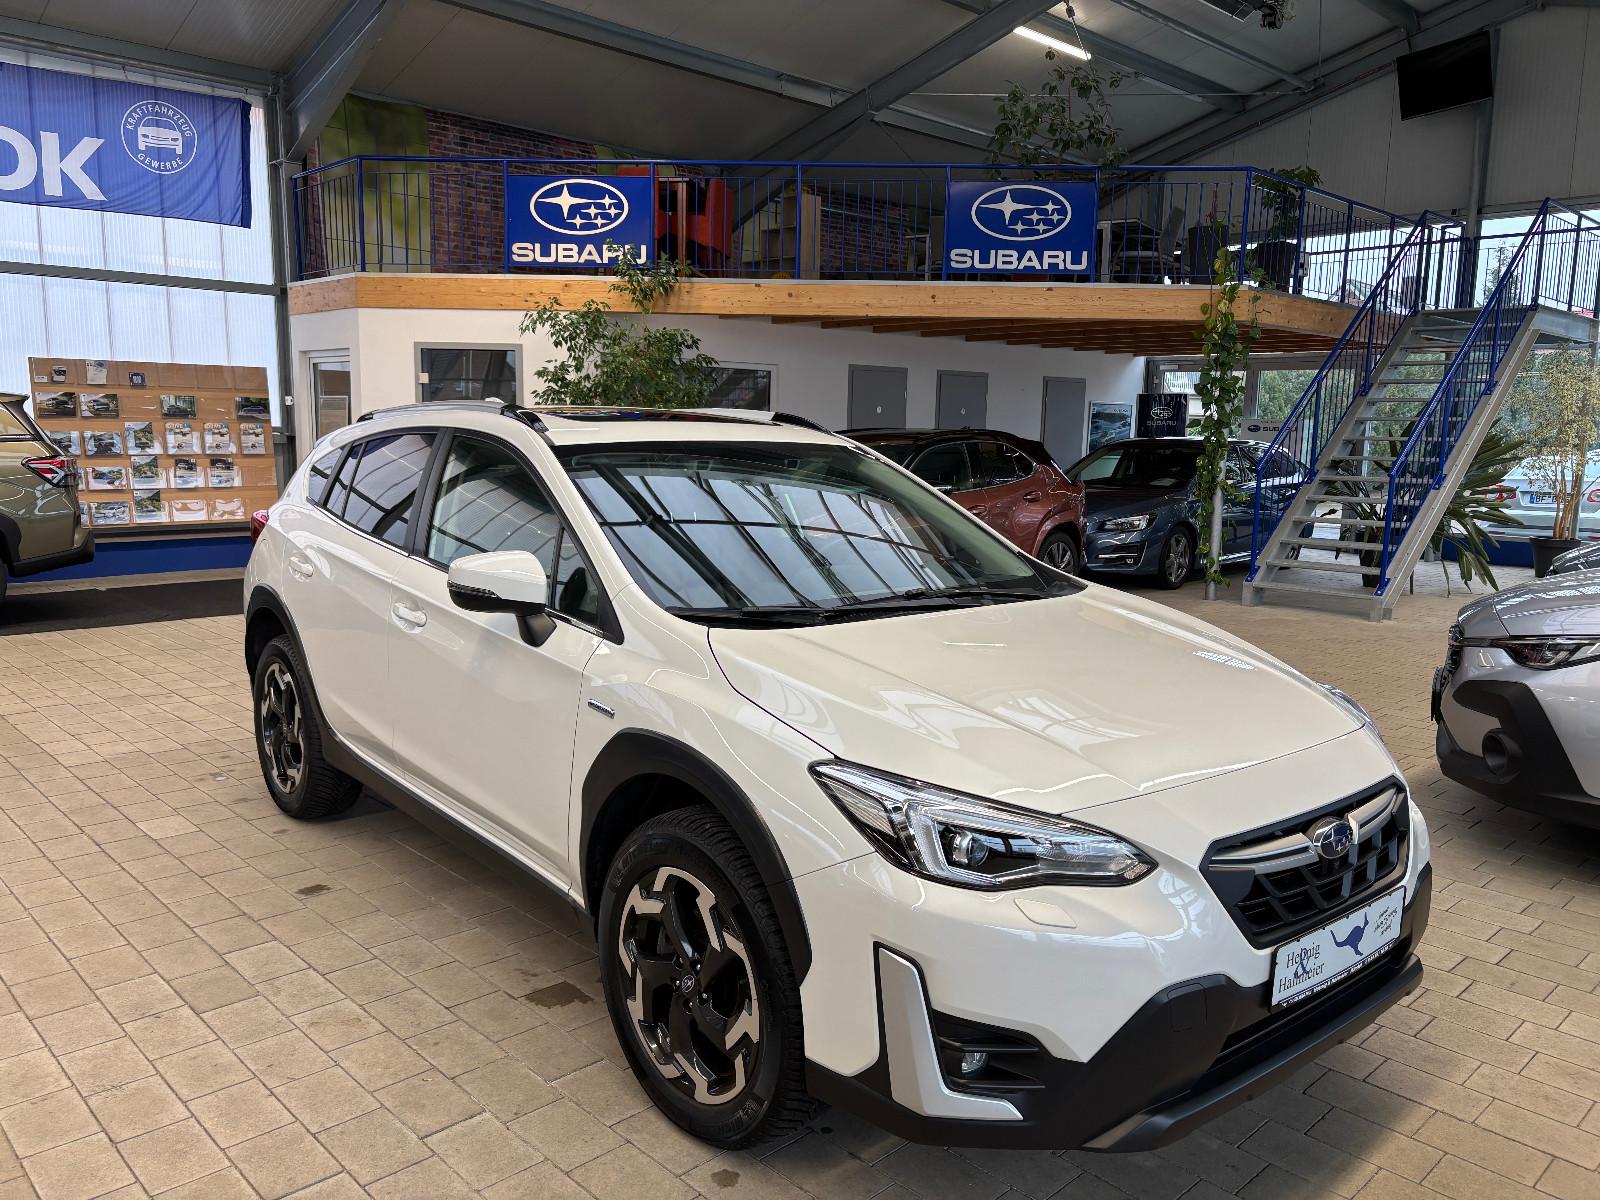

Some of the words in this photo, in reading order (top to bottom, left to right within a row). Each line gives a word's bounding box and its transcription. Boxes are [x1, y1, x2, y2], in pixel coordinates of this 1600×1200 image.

[126, 104, 193, 137] KRAFTFAHRZEUG
[138, 153, 183, 170] GEWERBE
[511, 242, 647, 265] SUBARU
[949, 248, 1088, 270] SUBARU
